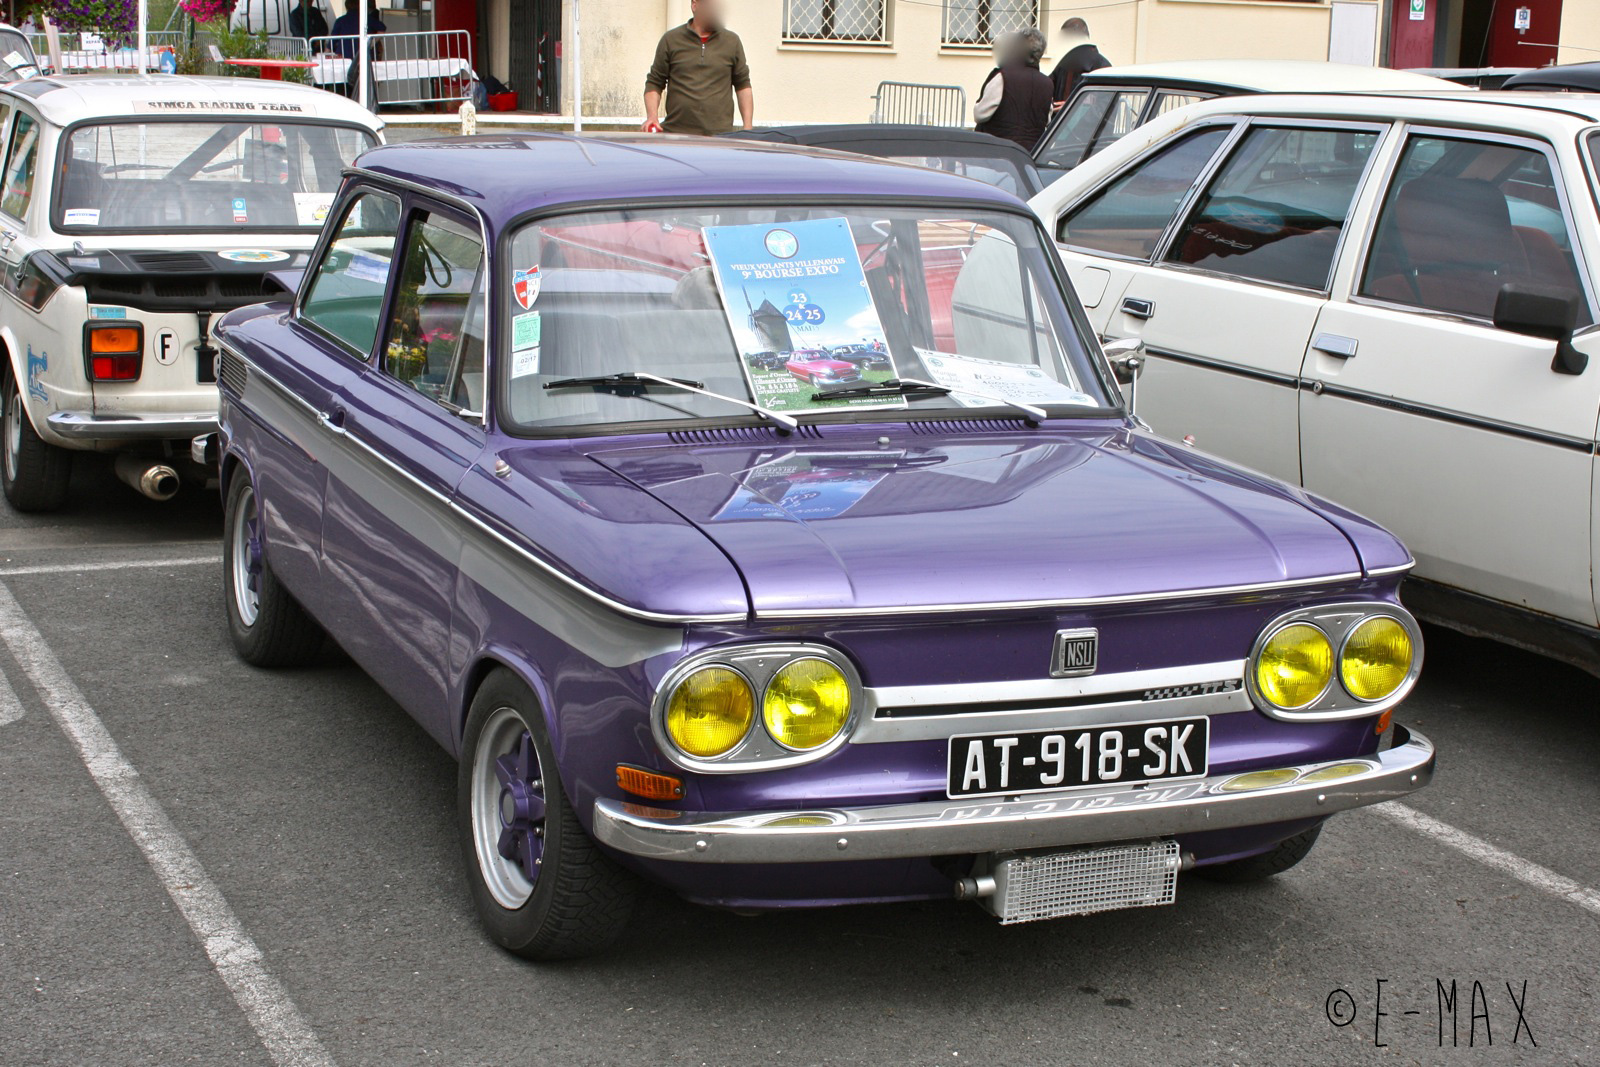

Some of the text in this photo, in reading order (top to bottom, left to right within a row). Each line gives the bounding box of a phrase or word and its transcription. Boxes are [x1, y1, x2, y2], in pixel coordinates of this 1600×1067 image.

[148, 101, 303, 112] SIMCA RACING TEAM
[730, 257, 846, 271] VIEUX VOLANTS VILLENAVAIS
[754, 267, 804, 279] BOURSE
[806, 264, 839, 276] EXPO
[791, 292, 808, 303] 23
[785, 309, 821, 321] 24 25
[160, 333, 173, 360] F
[1067, 640, 1093, 668] NSU
[1201, 680, 1238, 695] TTS
[961, 724, 1195, 792] AT-918-SK
